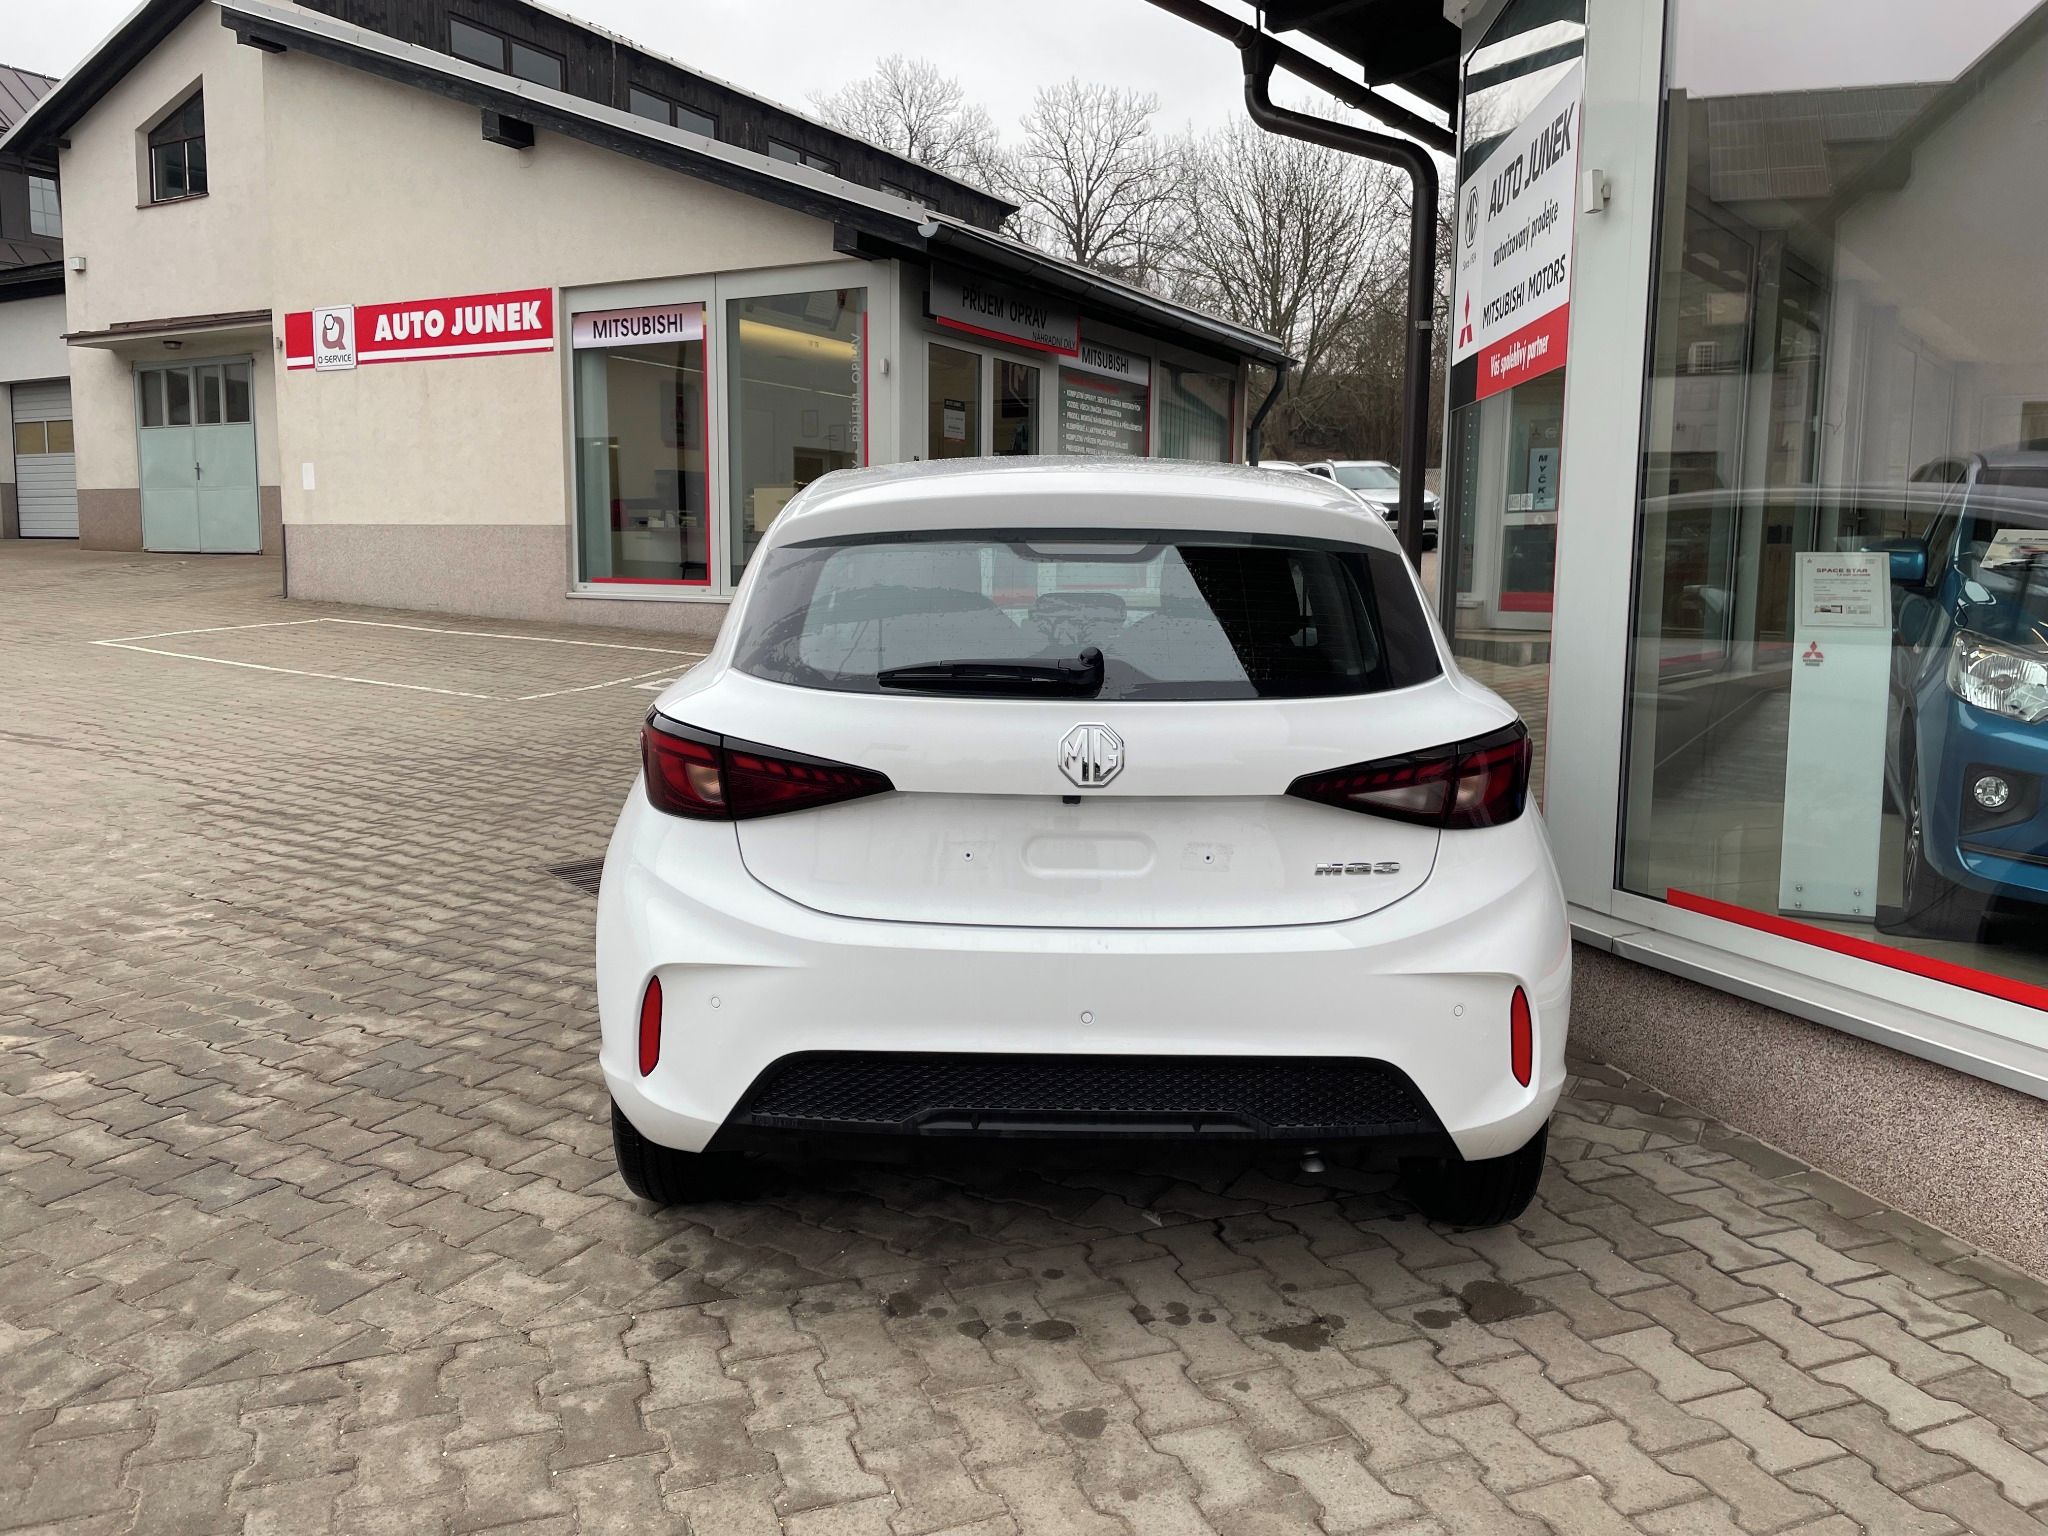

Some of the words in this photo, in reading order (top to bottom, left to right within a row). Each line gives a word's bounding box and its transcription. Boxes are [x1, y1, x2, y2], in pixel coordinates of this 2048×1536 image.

[1488, 154, 1524, 222] AUTO
[1524, 100, 1575, 190] JUNEK
[1493, 217, 1530, 267] autorizovaný
[1530, 199, 1559, 248] prodejce
[962, 283, 1004, 318] PŘÍJEM
[1010, 300, 1048, 329] OPRAV
[1482, 281, 1525, 330] MITSUBISHI
[1528, 253, 1566, 302] MOTORS
[374, 310, 445, 342] AUTO
[451, 300, 542, 336] JUNEK
[592, 313, 683, 339] MITSUBISHI
[1081, 347, 1129, 375] MITSUBISHI
[1490, 353, 1501, 378] Váš
[1500, 339, 1527, 380] spolehlivý
[1526, 334, 1549, 369] partner
[1062, 726, 1120, 783] MG
